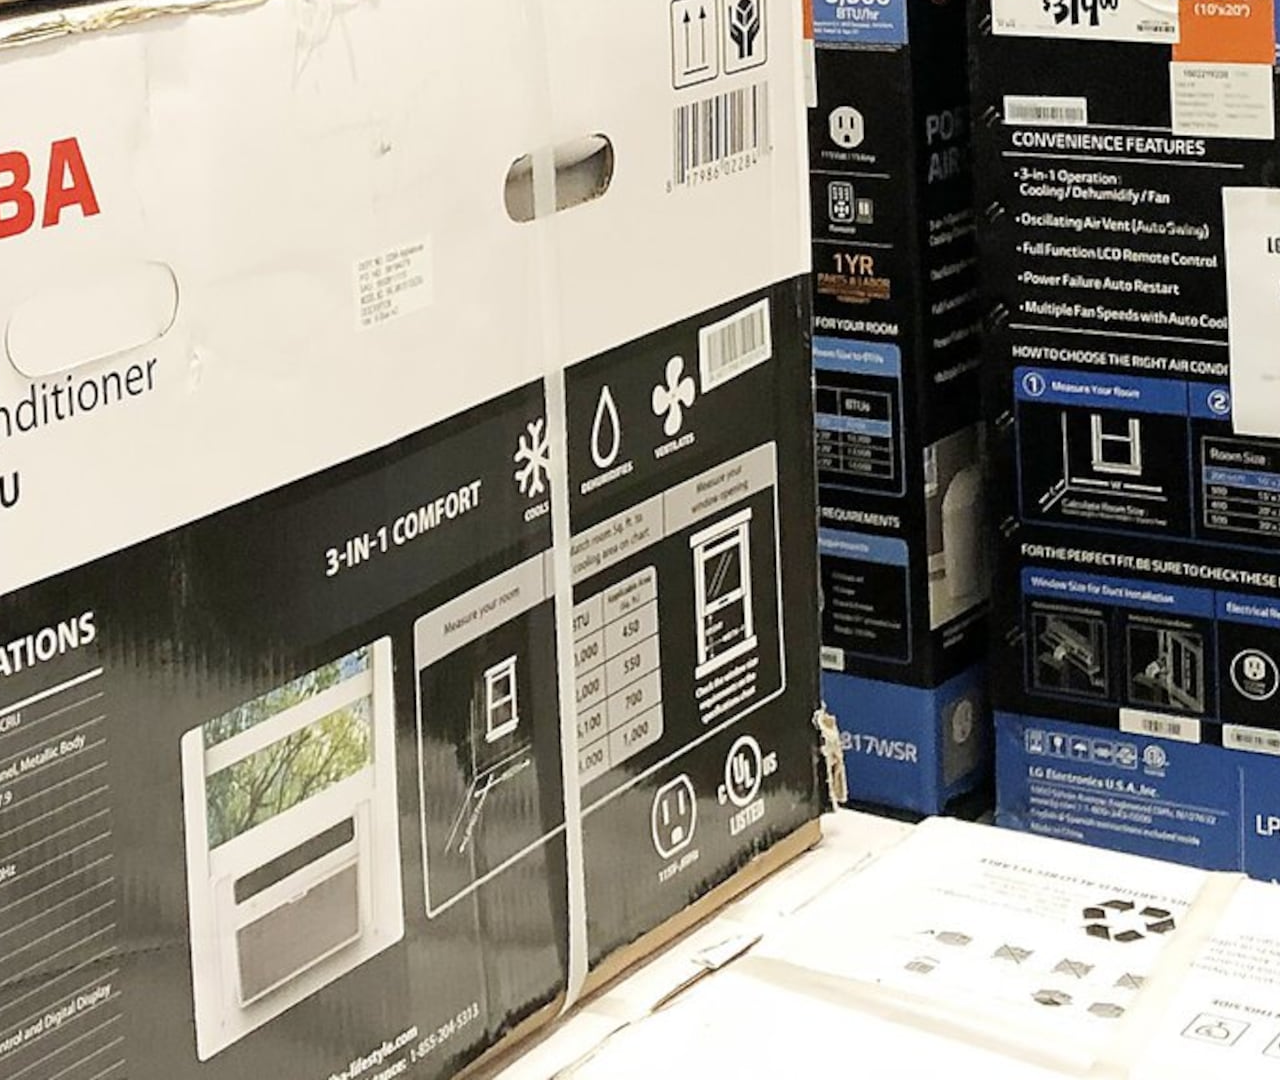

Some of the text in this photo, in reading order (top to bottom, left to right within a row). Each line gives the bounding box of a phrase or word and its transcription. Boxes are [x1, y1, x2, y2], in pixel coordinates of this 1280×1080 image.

[836, 6, 878, 21] BTU/hr
[1012, 131, 1205, 157] CONVENIENCE FEATURES
[655, 431, 695, 459] VENTILATES
[325, 479, 482, 576] 3-IN-1 COMFORT
